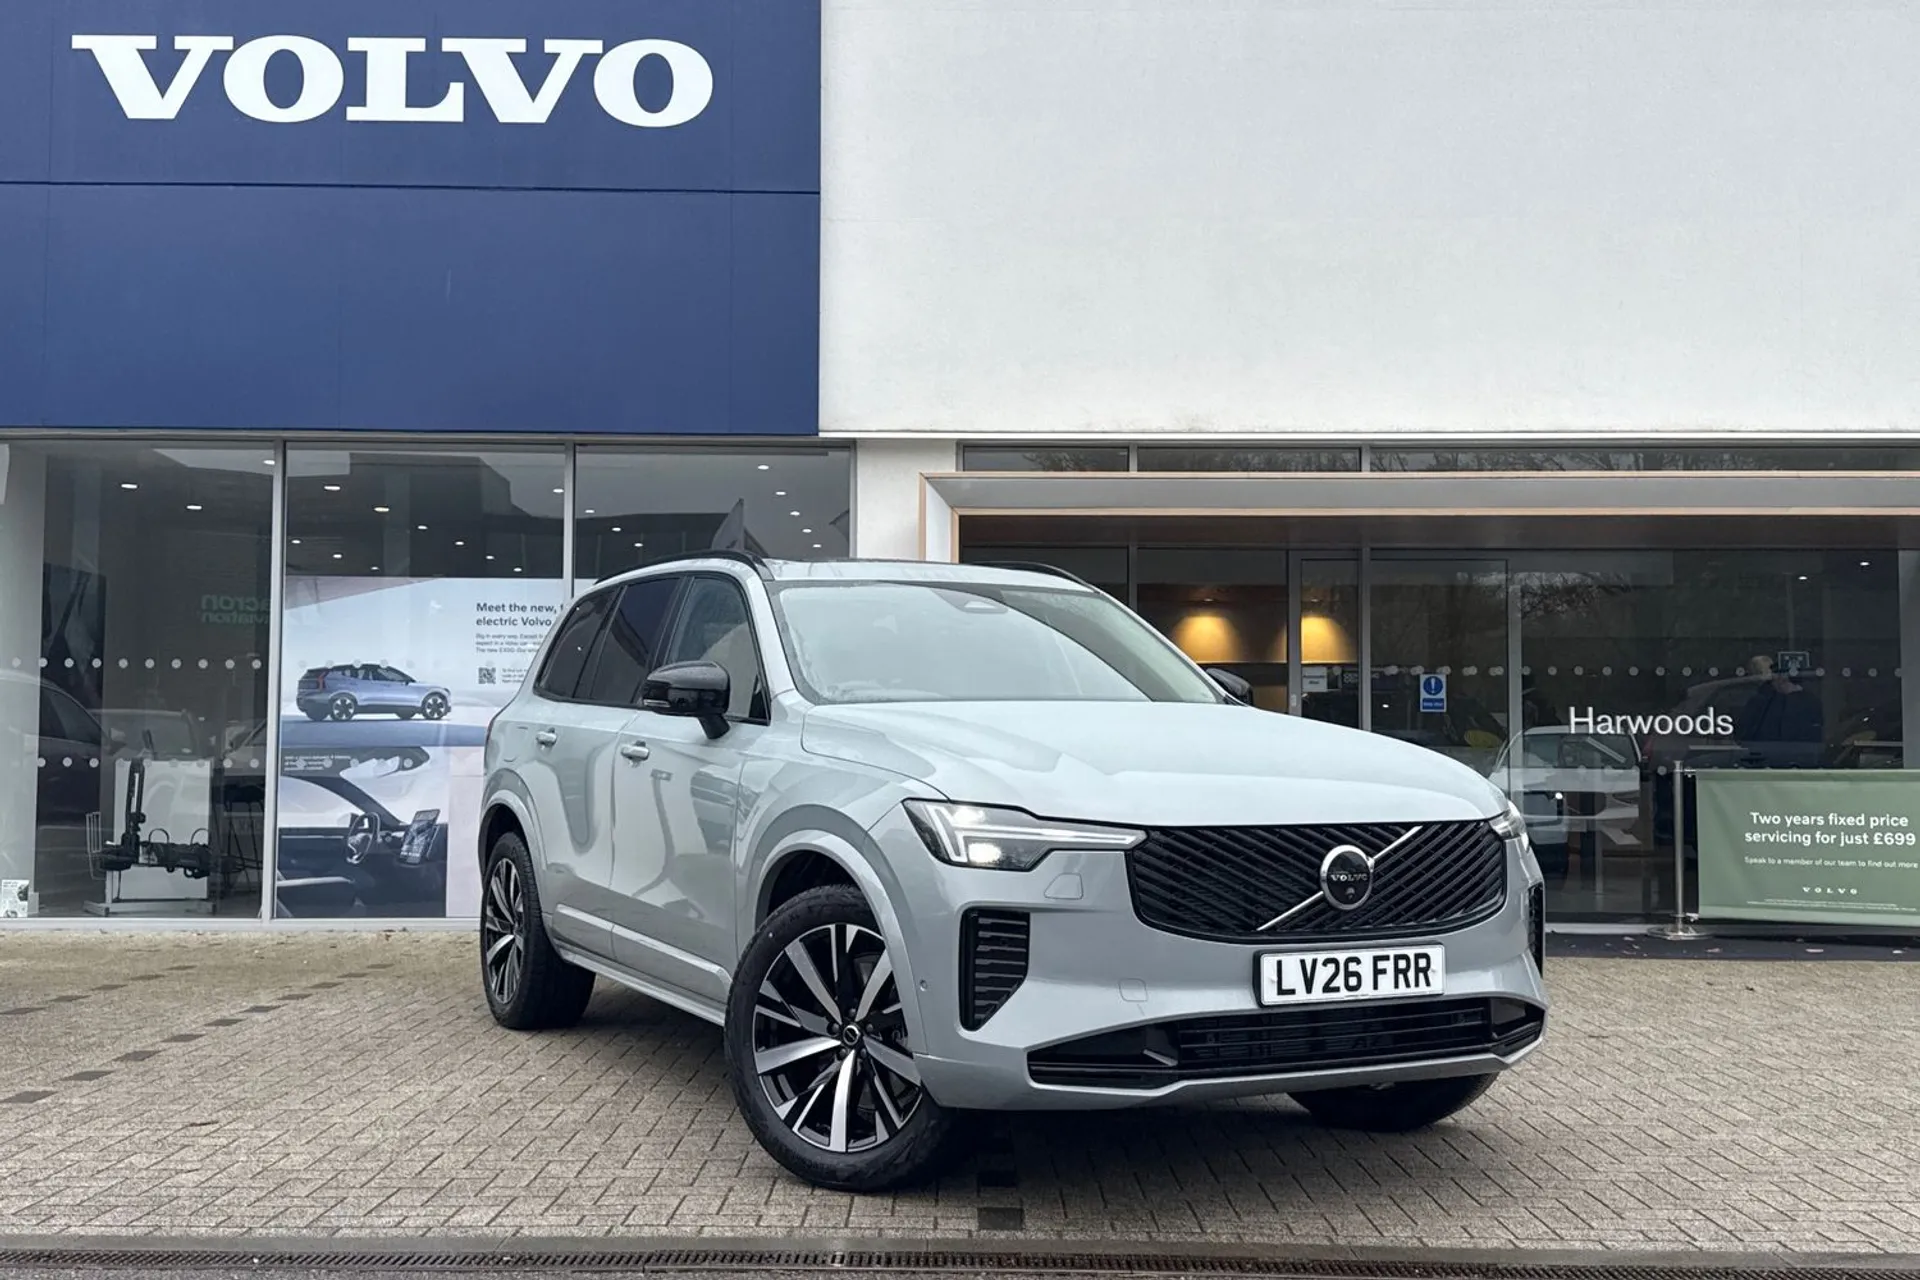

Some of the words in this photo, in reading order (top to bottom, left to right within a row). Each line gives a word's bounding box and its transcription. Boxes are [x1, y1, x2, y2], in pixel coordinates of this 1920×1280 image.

[72, 34, 713, 127] VOLVO
[476, 602, 506, 612] Meet
[509, 602, 527, 612] the
[530, 604, 557, 614] new,
[476, 616, 518, 626] electric
[521, 616, 552, 626] Volvo
[1568, 706, 1735, 736] Harwoods
[1750, 811, 1781, 825] Two
[1784, 814, 1825, 828] years
[1828, 813, 1866, 826] fixed
[1869, 814, 1909, 829] price
[1744, 830, 1811, 846] servicing
[1815, 831, 1837, 844] for
[1839, 832, 1869, 847] just
[1873, 832, 1917, 846] £699
[1744, 856, 1767, 866] Speak
[1768, 857, 1776, 865] to
[1783, 857, 1814, 866] member
[1815, 858, 1823, 866] of
[1838, 859, 1857, 867] team
[1867, 859, 1882, 868] find
[1330, 873, 1368, 882] VOLVO
[1802, 886, 1858, 895] VOLVO
[1276, 956, 1362, 996] LV26
[1372, 952, 1431, 991] FRR
